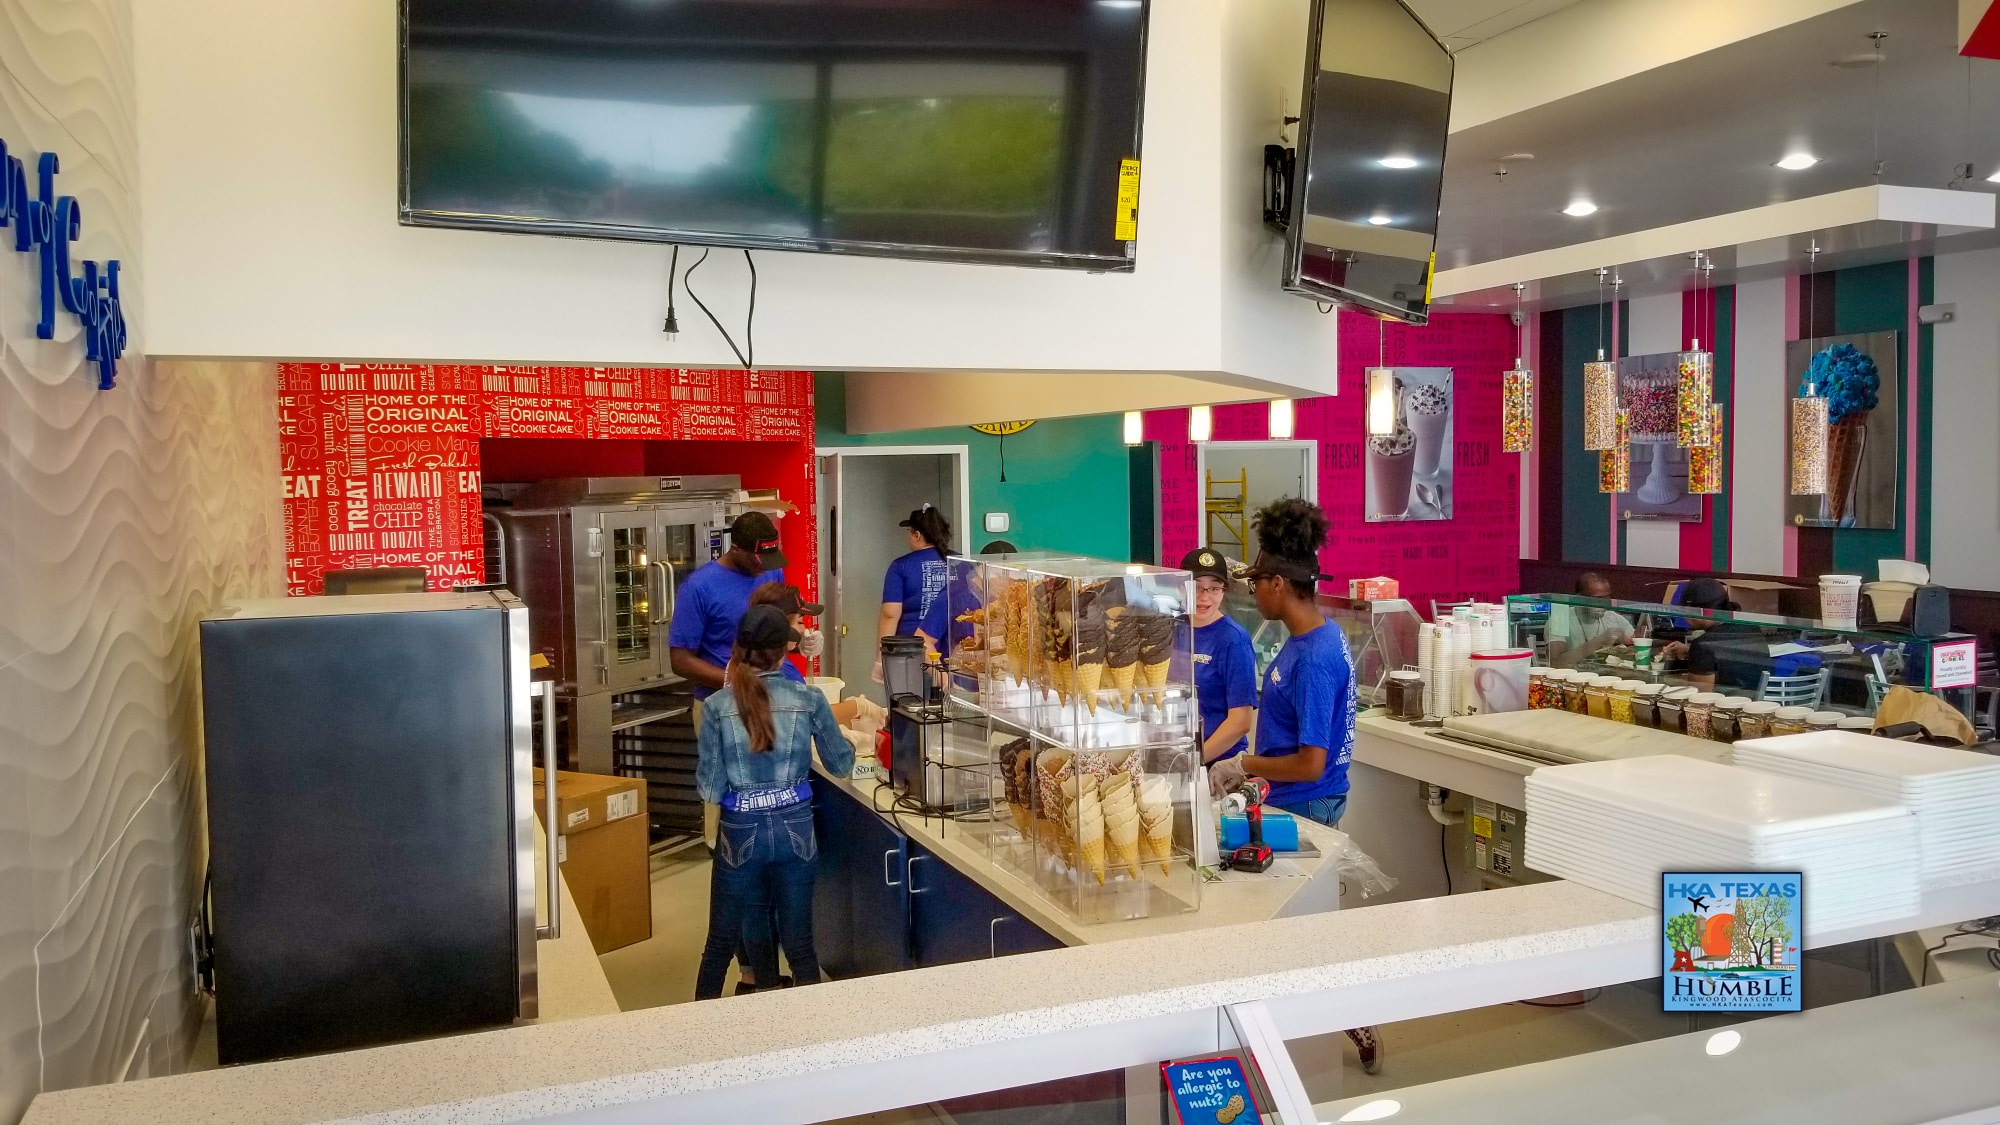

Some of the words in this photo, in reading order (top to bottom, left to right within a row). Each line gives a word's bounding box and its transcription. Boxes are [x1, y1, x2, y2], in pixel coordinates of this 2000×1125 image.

[320, 373, 368, 390] DOUBLE
[373, 374, 417, 390] DOOZIE
[482, 374, 511, 392] DOUBLE
[514, 376, 540, 394] DOOZIE
[689, 371, 711, 386] CHIP
[584, 380, 608, 397] DOUBLE
[612, 382, 632, 398] DOOZIE
[670, 386, 690, 400] DOUBLE
[365, 394, 414, 406] HOME
[418, 396, 438, 405] OF
[442, 395, 468, 405] THE
[509, 396, 538, 408] HOME
[540, 398, 553, 408] OF
[555, 399, 572, 408] THE
[608, 400, 632, 411] HOME
[634, 402, 644, 410] OF
[645, 403, 660, 412] THE
[367, 406, 468, 421] ORIGINAL
[510, 407, 574, 422] ORIGINAL
[690, 404, 710, 414] HOME
[712, 406, 720, 414] OF
[722, 406, 736, 414] THE
[760, 407, 778, 416] HOME
[780, 408, 788, 416] OF
[788, 408, 800, 416] THE
[610, 411, 661, 424] ORIGINAL
[690, 414, 736, 426] ORIGINAL
[761, 416, 800, 427] ORIGINAL
[298, 394, 319, 460] SUGAR
[323, 412, 335, 454] yummy
[367, 424, 428, 434] COOKIE
[432, 422, 468, 432] CAKE
[511, 423, 547, 434] COOKIE
[549, 424, 574, 434] CAKE
[610, 426, 640, 434] COOKIE
[640, 426, 662, 434] CAKE
[691, 427, 717, 436] COOKIE
[718, 427, 736, 436] CAKE
[762, 428, 784, 436] COOKIE
[785, 428, 800, 436] CAKE
[368, 436, 431, 453] Cookie
[436, 436, 470, 452] Man
[1325, 443, 1360, 470] FRESH
[1457, 442, 1490, 468] FRESH
[281, 474, 320, 498] EAT
[326, 460, 340, 496] gooey
[373, 472, 442, 499] REWARD
[346, 479, 370, 532] TREAT
[373, 502, 423, 512] chocolate
[444, 470, 459, 546] snickerdoodle
[326, 502, 340, 531] ooey
[374, 512, 423, 528] CHIP
[460, 498, 468, 546] BROWNIES
[469, 494, 478, 546] PEANUT
[296, 499, 310, 552] PEANUT
[308, 498, 320, 552] BUTTER
[329, 532, 375, 552] DOUBLE
[382, 530, 426, 550] DOOZIE
[428, 528, 436, 548] TIME
[374, 554, 422, 564] HOME
[426, 552, 446, 562] OF
[450, 550, 475, 560] THE
[1402, 546, 1423, 560] MADE
[1426, 545, 1450, 560] FRESH
[750, 793, 777, 809] REWARD
[780, 789, 792, 801] EAT
[1182, 1068, 1204, 1082] Are
[1206, 1067, 1232, 1082] you
[1177, 1080, 1224, 1096] allergic
[1227, 1078, 1240, 1090] to
[1188, 1093, 1224, 1109] nuts?
